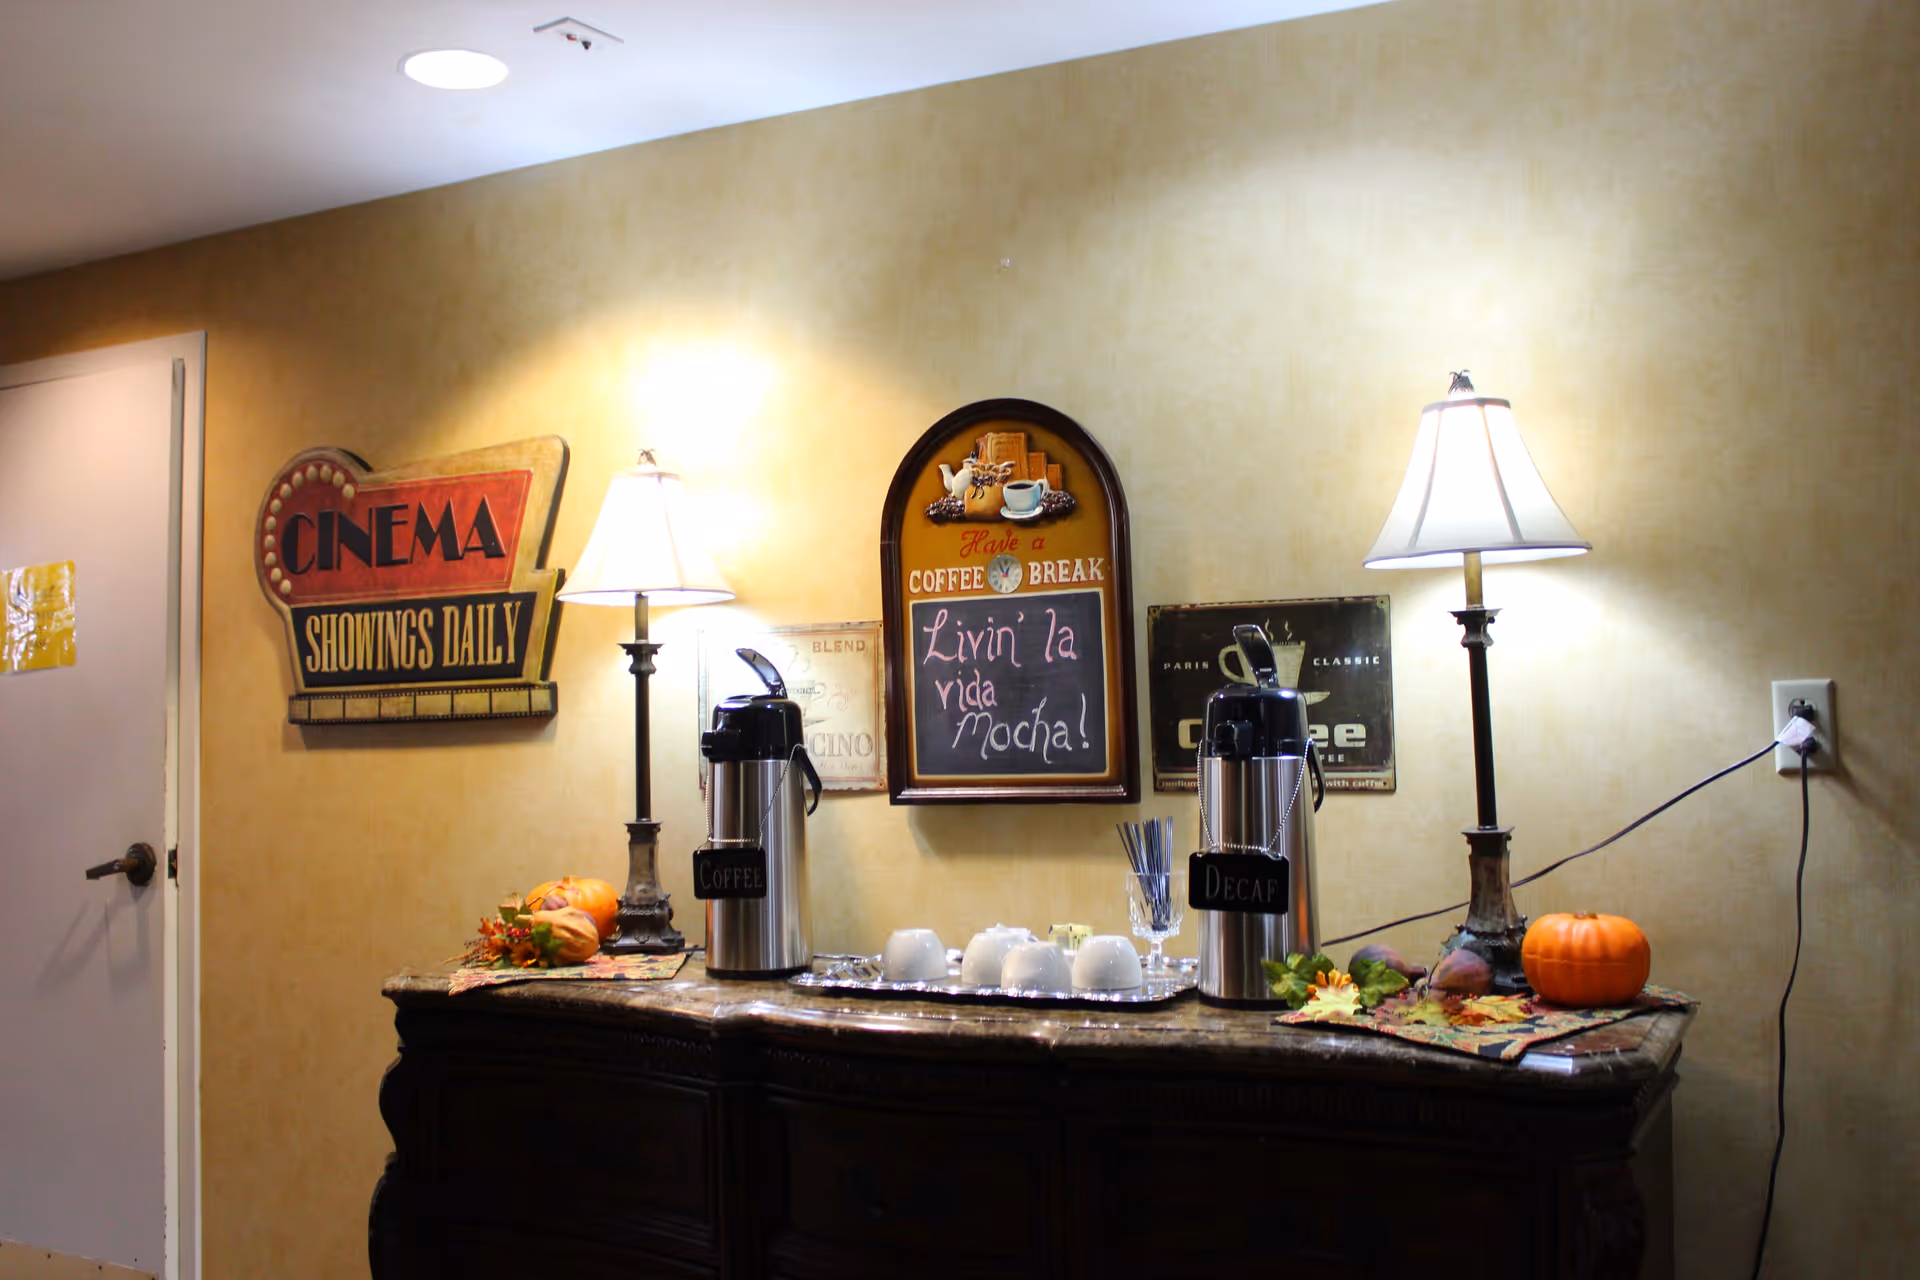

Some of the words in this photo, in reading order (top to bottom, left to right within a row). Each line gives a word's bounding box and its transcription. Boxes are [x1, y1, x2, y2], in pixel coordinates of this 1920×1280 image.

[281, 495, 506, 575] CINEMA
[960, 530, 1019, 559] Have
[1031, 537, 1046, 550] a
[908, 566, 985, 594] COFFEE
[1028, 557, 1105, 586] BREAK
[305, 608, 434, 673] SHOWINGS
[442, 602, 521, 667] DAILY
[812, 640, 866, 653] BLEND
[922, 609, 1025, 668] Livin'
[1045, 608, 1078, 663] la
[1163, 661, 1210, 670] PARIS
[1313, 656, 1380, 666] CLASSIC
[935, 668, 997, 712] vida
[700, 860, 763, 889] COFFEE
[1205, 863, 1278, 903] DECAF
